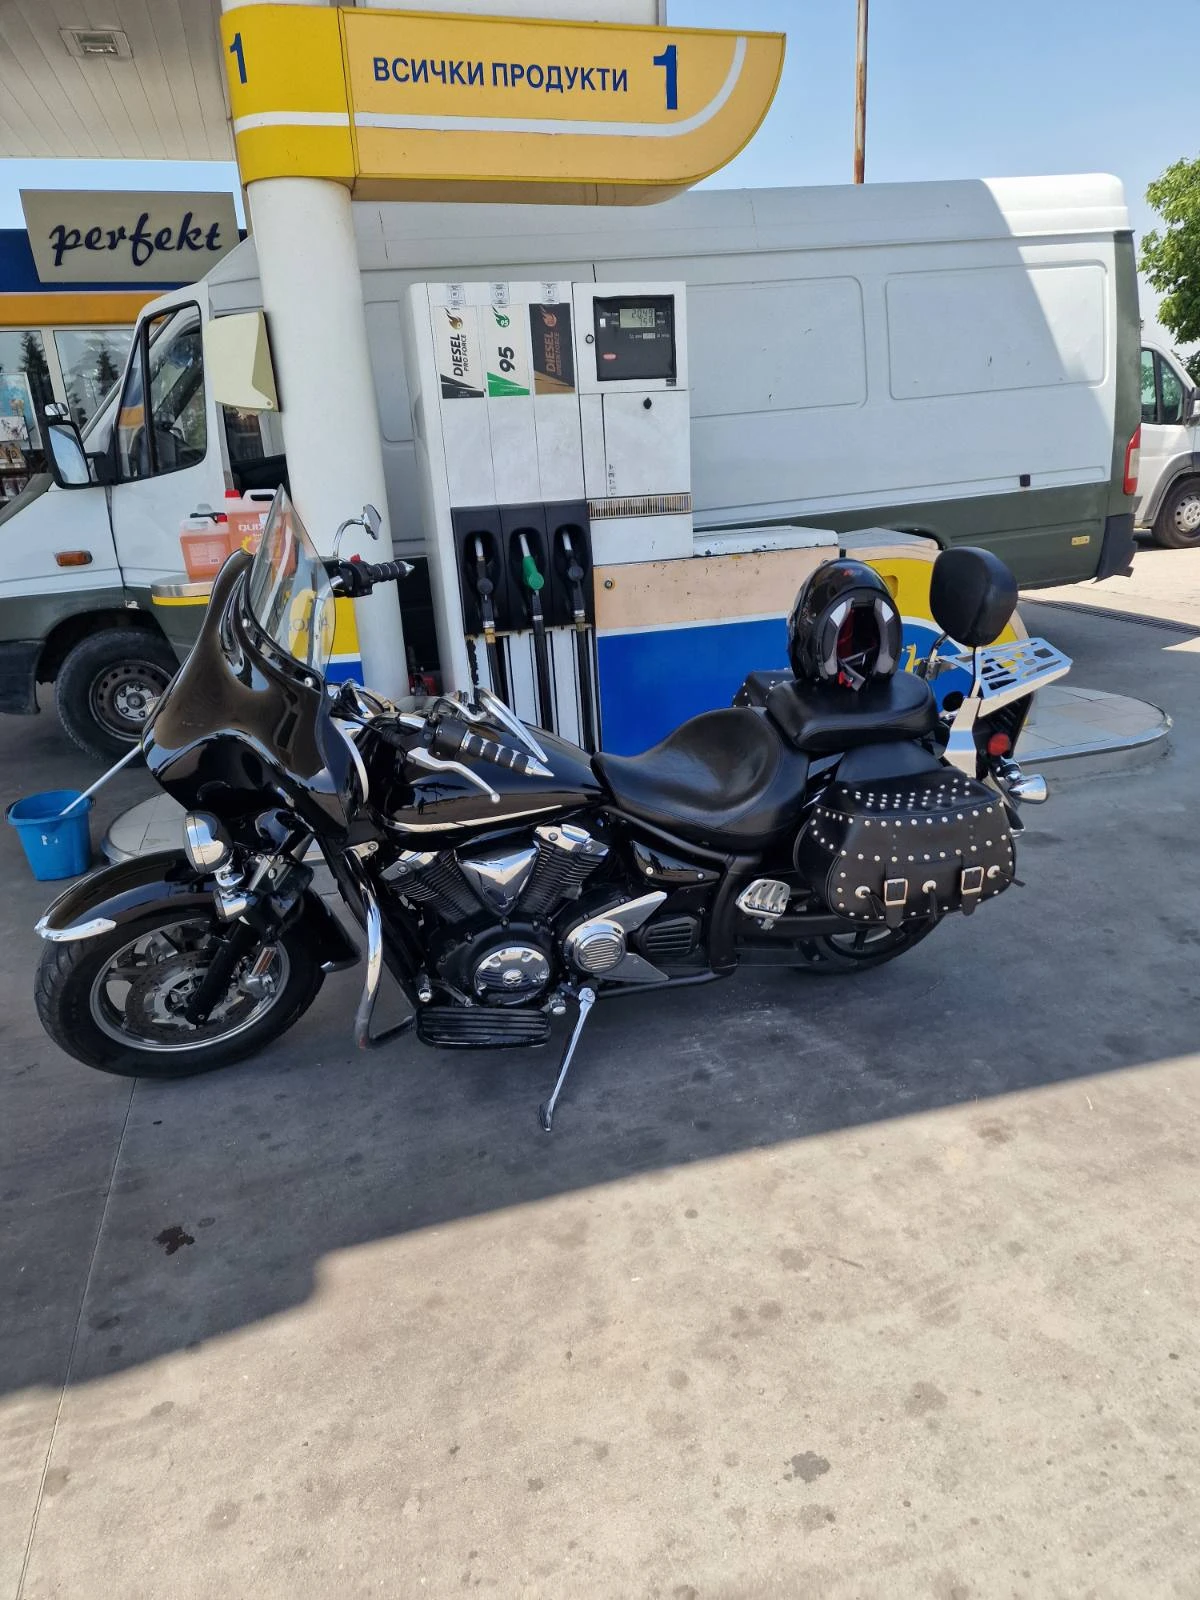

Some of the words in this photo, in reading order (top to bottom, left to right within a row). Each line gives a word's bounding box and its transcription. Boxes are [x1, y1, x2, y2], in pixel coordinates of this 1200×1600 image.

[230, 32, 248, 84] 1
[373, 56, 485, 86] ВСИЧКИ
[492, 62, 628, 94] ПРОДУКТИ
[653, 44, 679, 110] 1
[49, 211, 222, 267] perfekt
[450, 333, 464, 377] DIESEL
[460, 334, 468, 358] FORCE
[498, 346, 516, 373] 95
[544, 331, 556, 373] DIESEL
